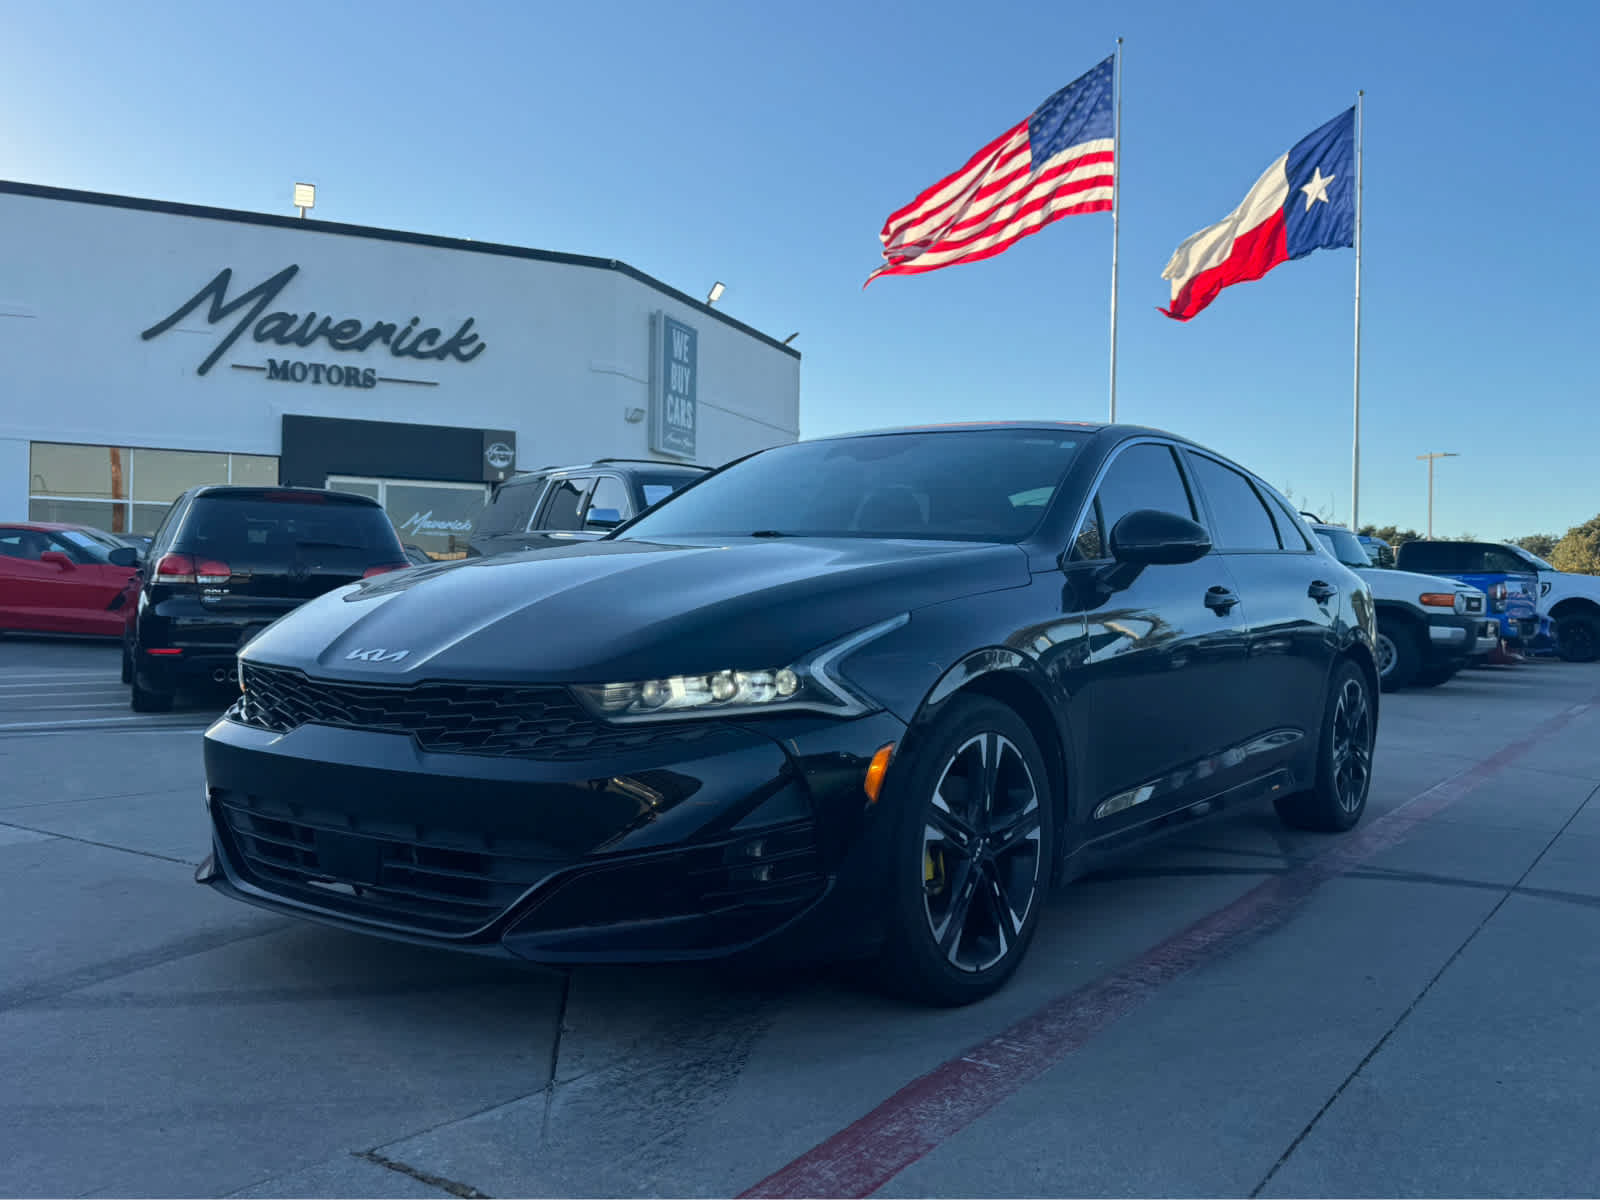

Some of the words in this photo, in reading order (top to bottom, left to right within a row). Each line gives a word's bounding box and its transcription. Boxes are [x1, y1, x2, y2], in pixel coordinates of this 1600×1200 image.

[141, 263, 486, 376] Maverick
[672, 328, 690, 363] WE
[266, 358, 378, 389] MOTORS
[671, 361, 691, 395] BUY
[667, 393, 693, 430] CARS
